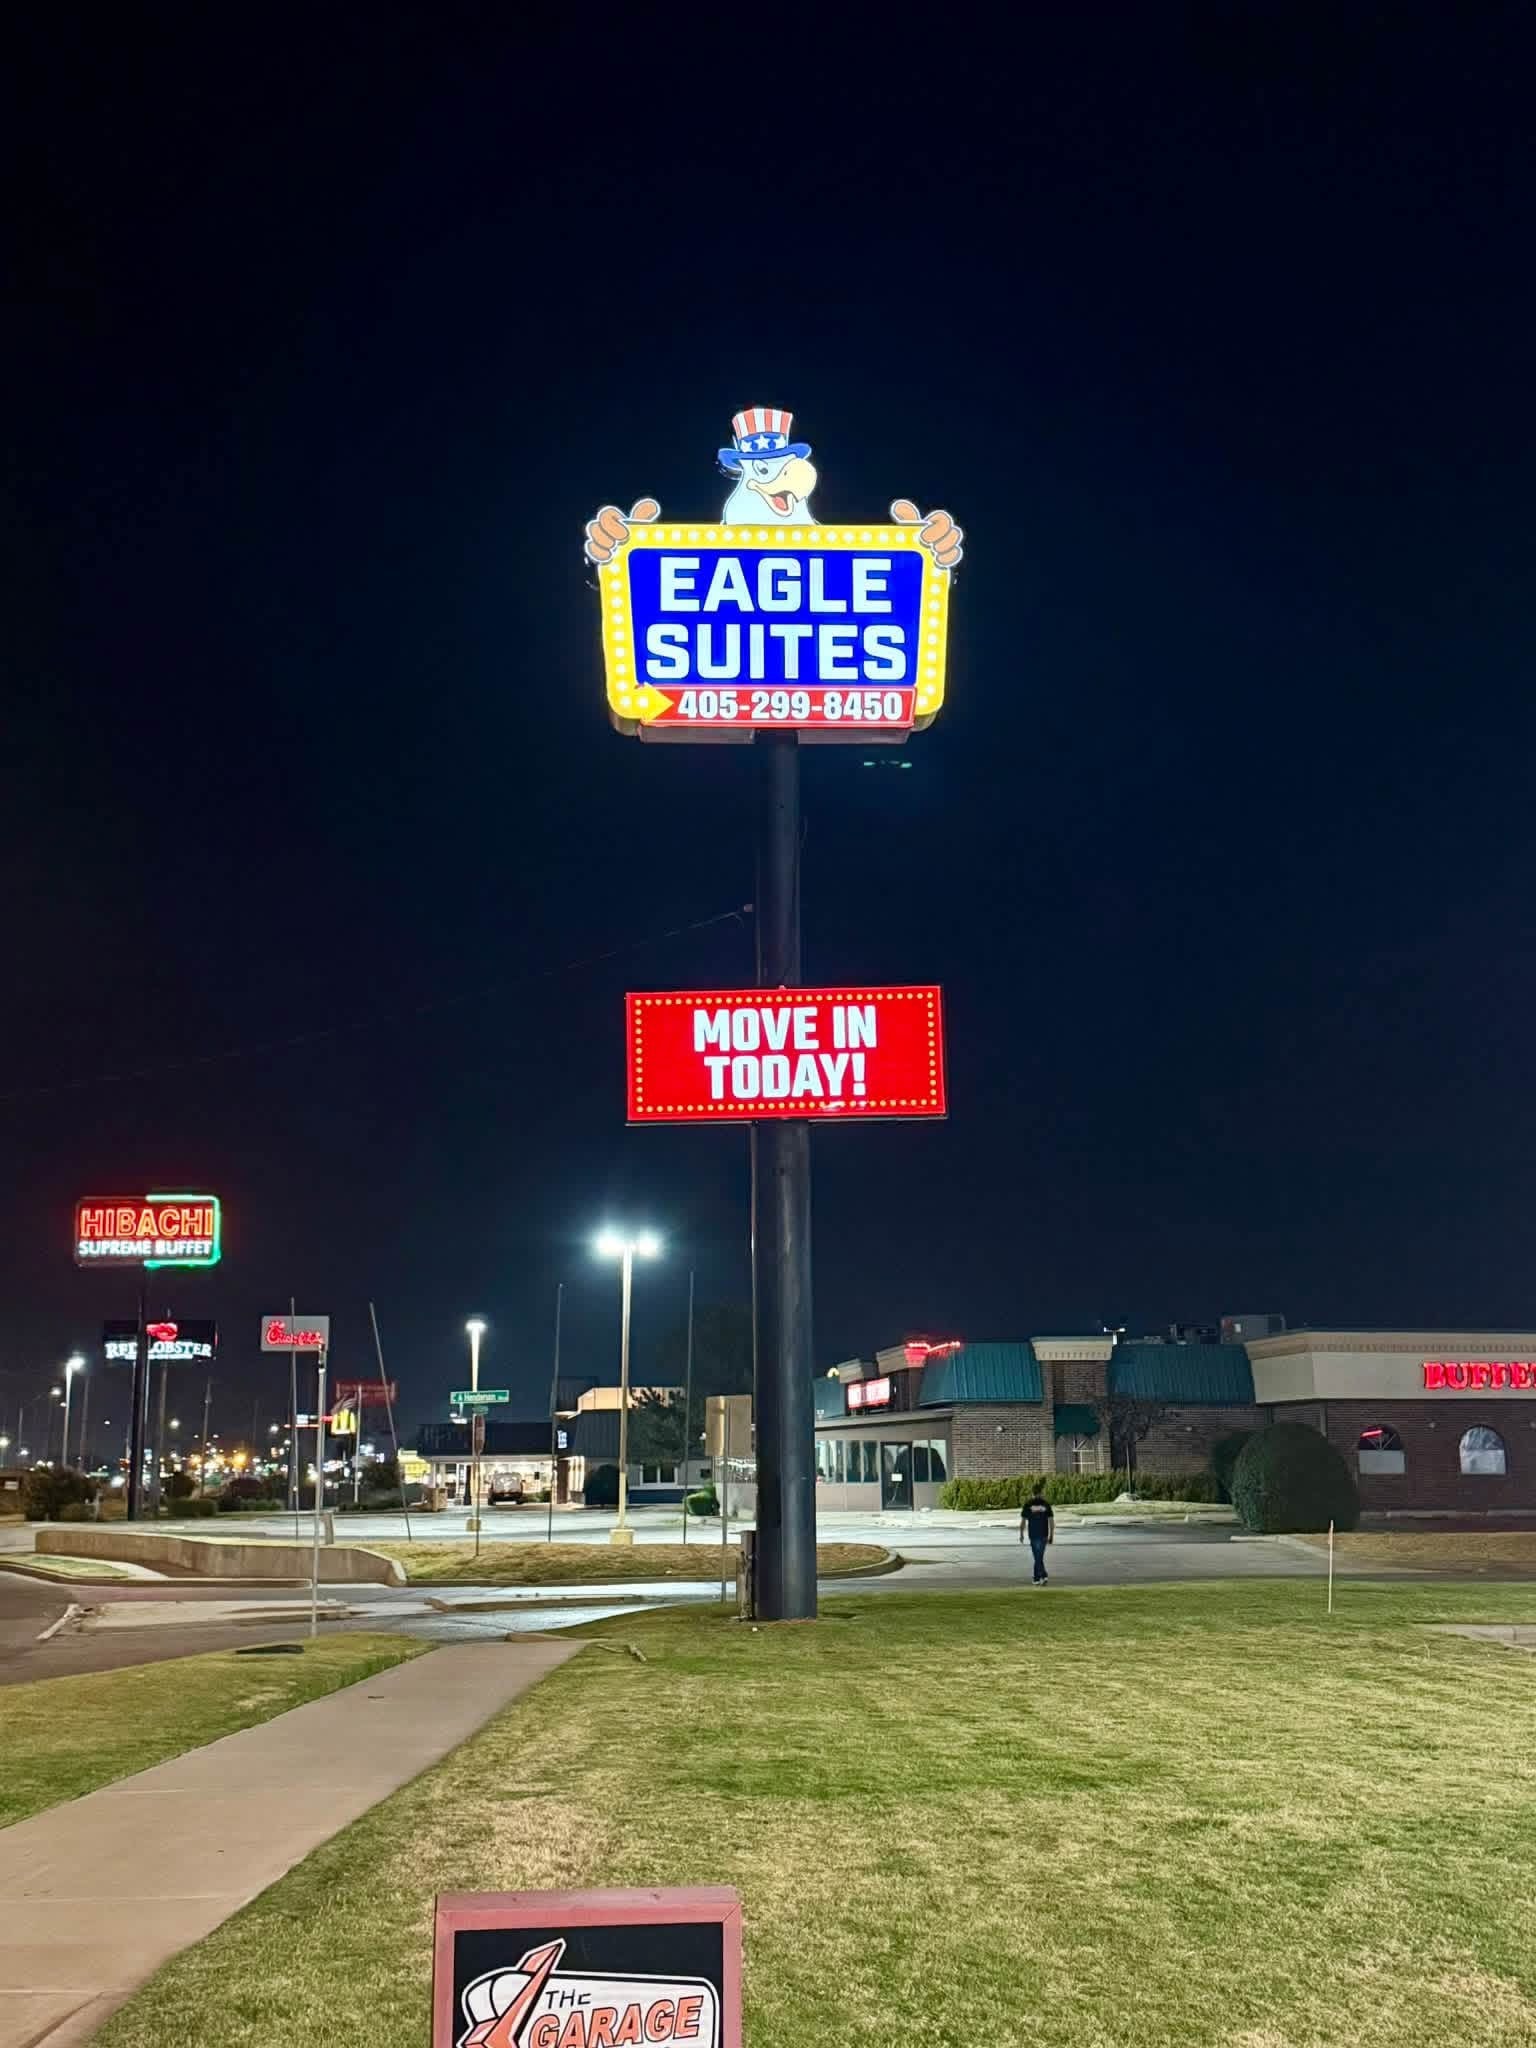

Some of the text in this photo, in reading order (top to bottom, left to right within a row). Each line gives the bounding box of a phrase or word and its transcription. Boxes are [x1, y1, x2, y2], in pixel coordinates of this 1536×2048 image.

[659, 556, 893, 614] EAGLE
[645, 623, 907, 681] SUITES
[677, 690, 904, 722] 405-299-8450
[693, 1005, 878, 1052] MOVE IN
[703, 1053, 867, 1100] TODAY!
[80, 1208, 214, 1237] HIBACHI
[78, 1239, 213, 1255] SUPREME BUFFET
[528, 1995, 704, 2048] GARAGE
[546, 1989, 592, 2009] THE
